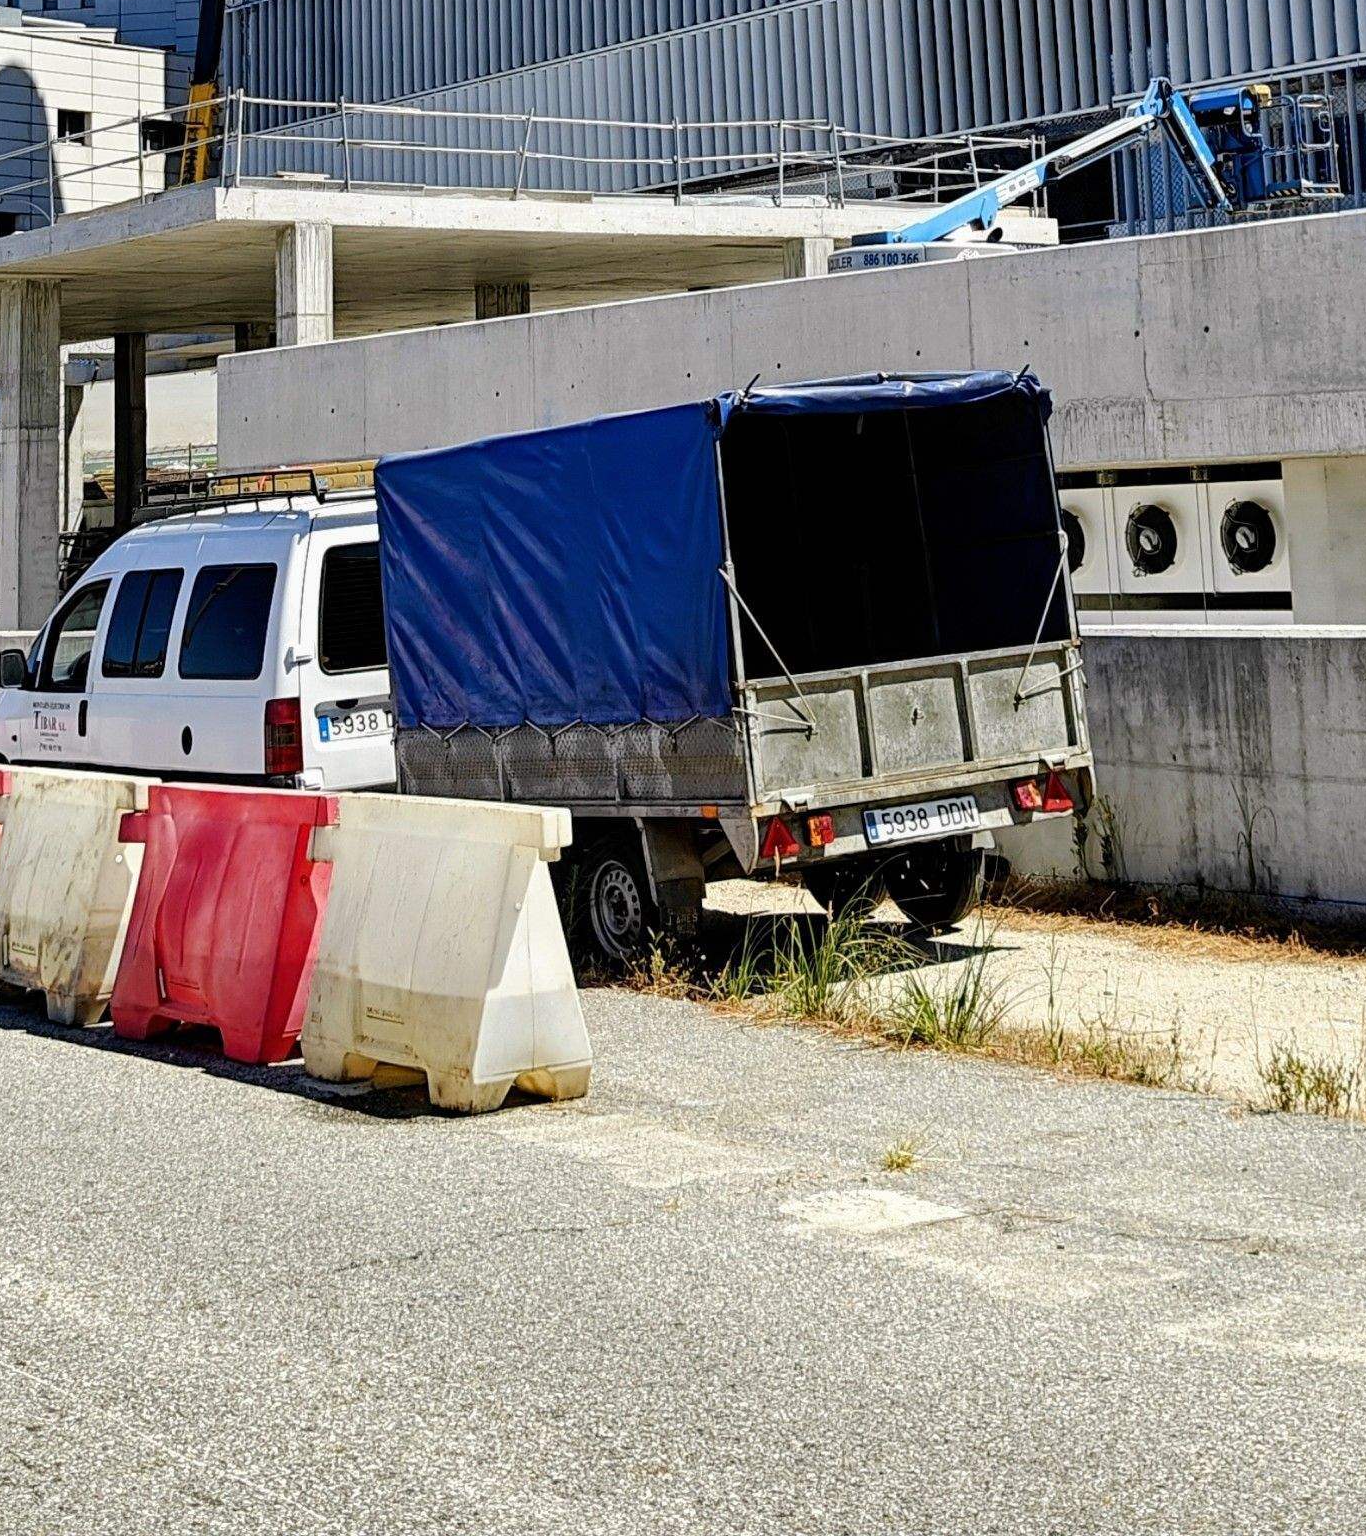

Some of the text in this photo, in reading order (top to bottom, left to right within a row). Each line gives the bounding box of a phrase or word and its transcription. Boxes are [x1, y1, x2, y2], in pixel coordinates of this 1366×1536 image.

[863, 253, 879, 266] 886
[881, 253, 898, 265] 100
[900, 253, 919, 265] 366
[34, 710, 57, 731] TIBAR
[331, 712, 379, 735] 5938
[881, 800, 976, 835] 5938 DDN
